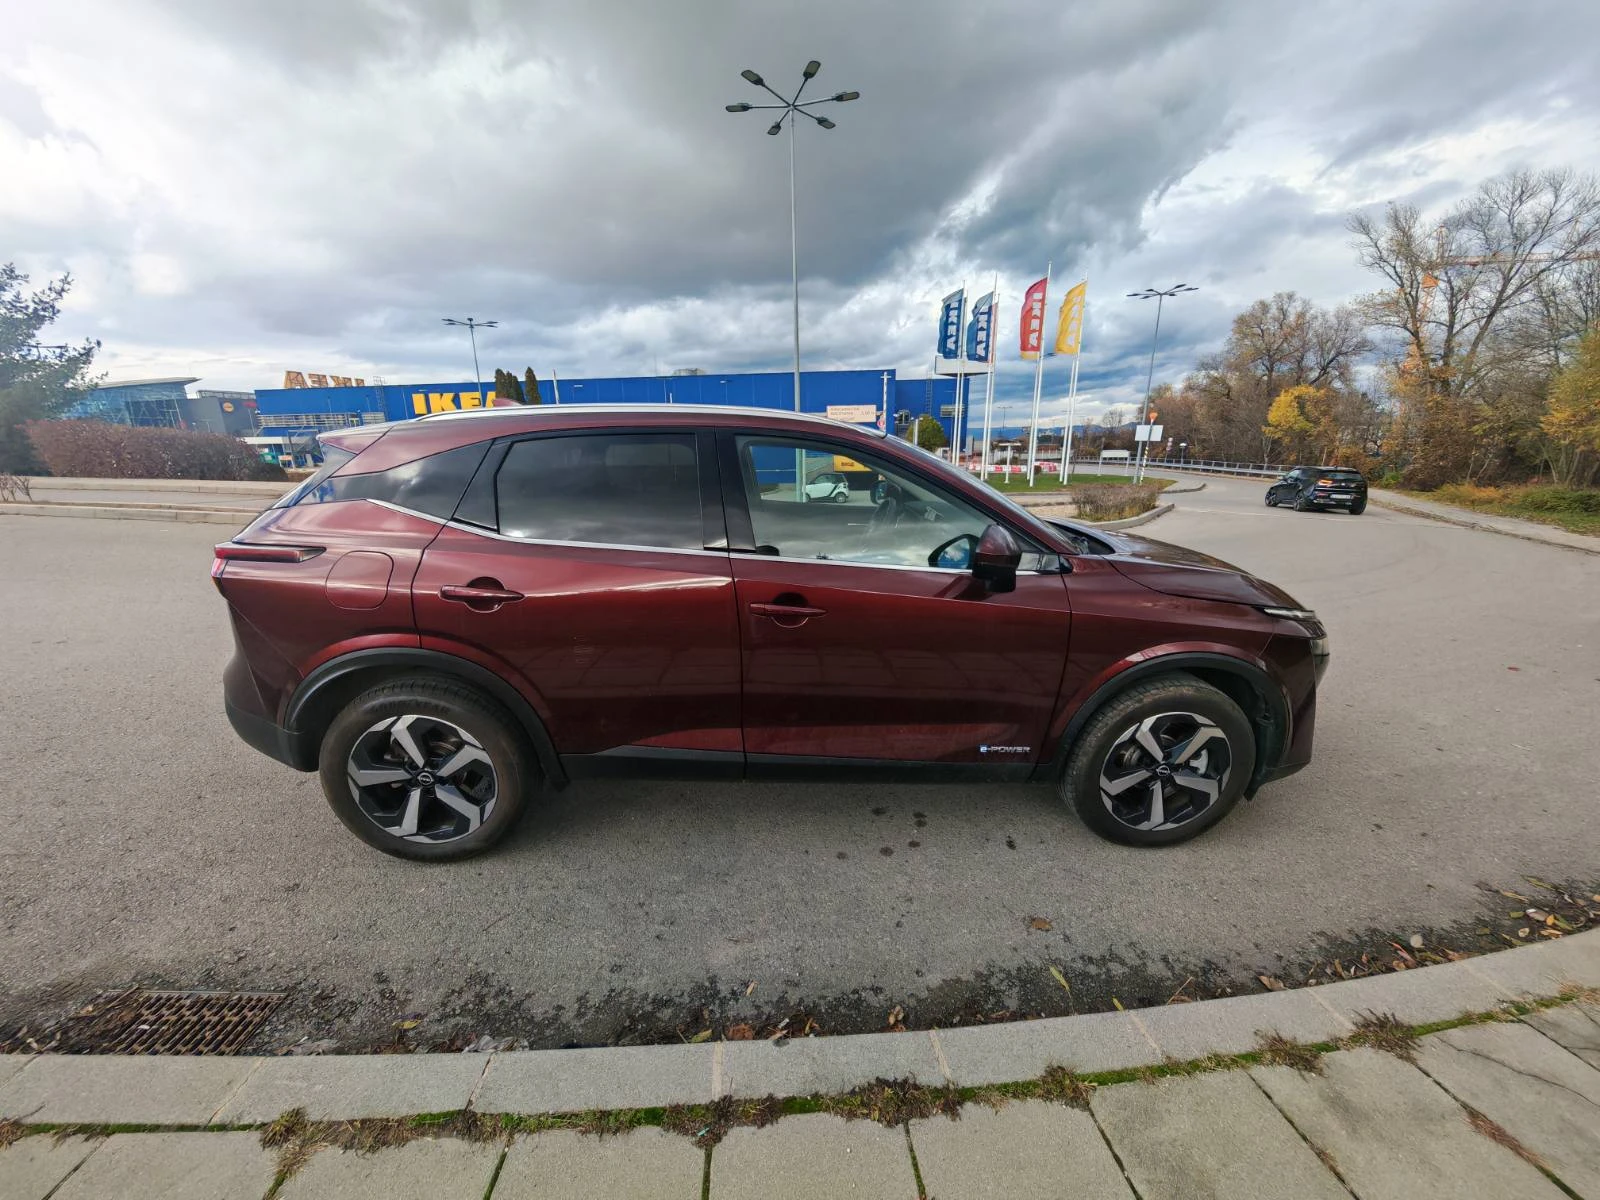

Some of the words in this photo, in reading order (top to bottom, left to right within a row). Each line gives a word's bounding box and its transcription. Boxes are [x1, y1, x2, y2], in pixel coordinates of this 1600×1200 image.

[946, 301, 958, 350] IKEA
[976, 305, 989, 357] IKEA
[1028, 292, 1043, 347] IKEA
[979, 745, 1031, 753] e-POWER
